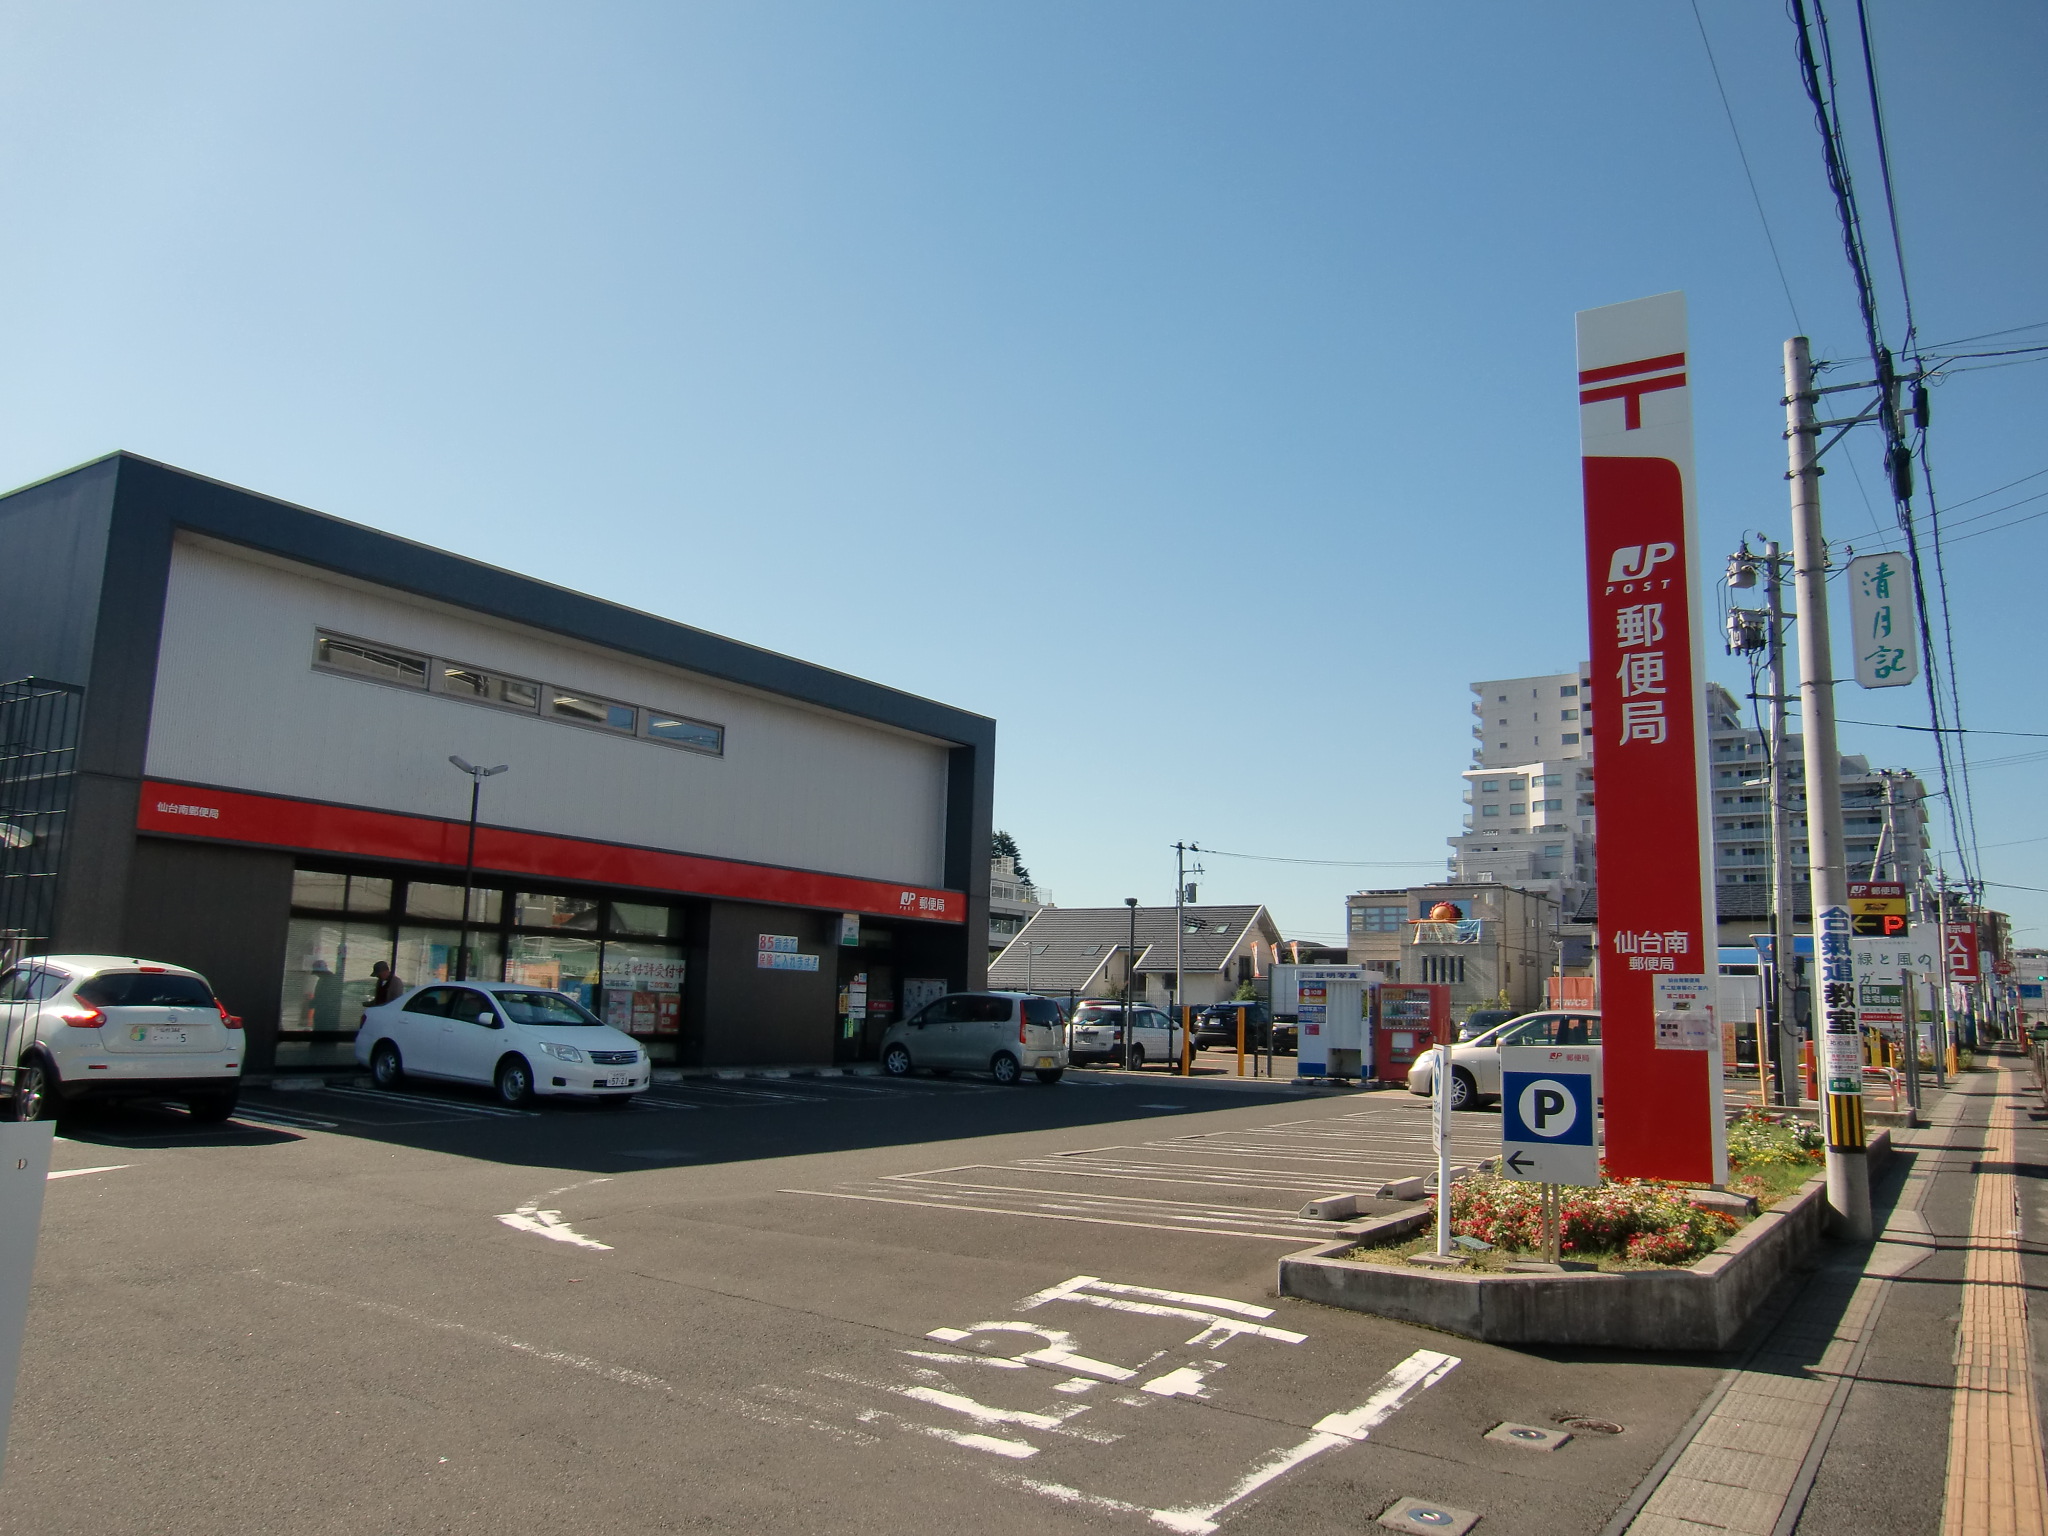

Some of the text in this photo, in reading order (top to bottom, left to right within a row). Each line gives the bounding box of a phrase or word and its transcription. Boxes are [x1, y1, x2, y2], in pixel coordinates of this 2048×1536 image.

[1605, 578, 1671, 596] POST
[1863, 563, 1906, 679] 清月記
[1616, 602, 1667, 746] 郵便局
[157, 802, 219, 819] 仙台南郵便局
[919, 896, 945, 913] 郵便局
[1884, 916, 1904, 935] P
[1613, 930, 1688, 954] 仙台南
[1948, 935, 1969, 970] 入口
[1628, 956, 1674, 971] 郵便局
[1533, 1089, 1565, 1129] P
